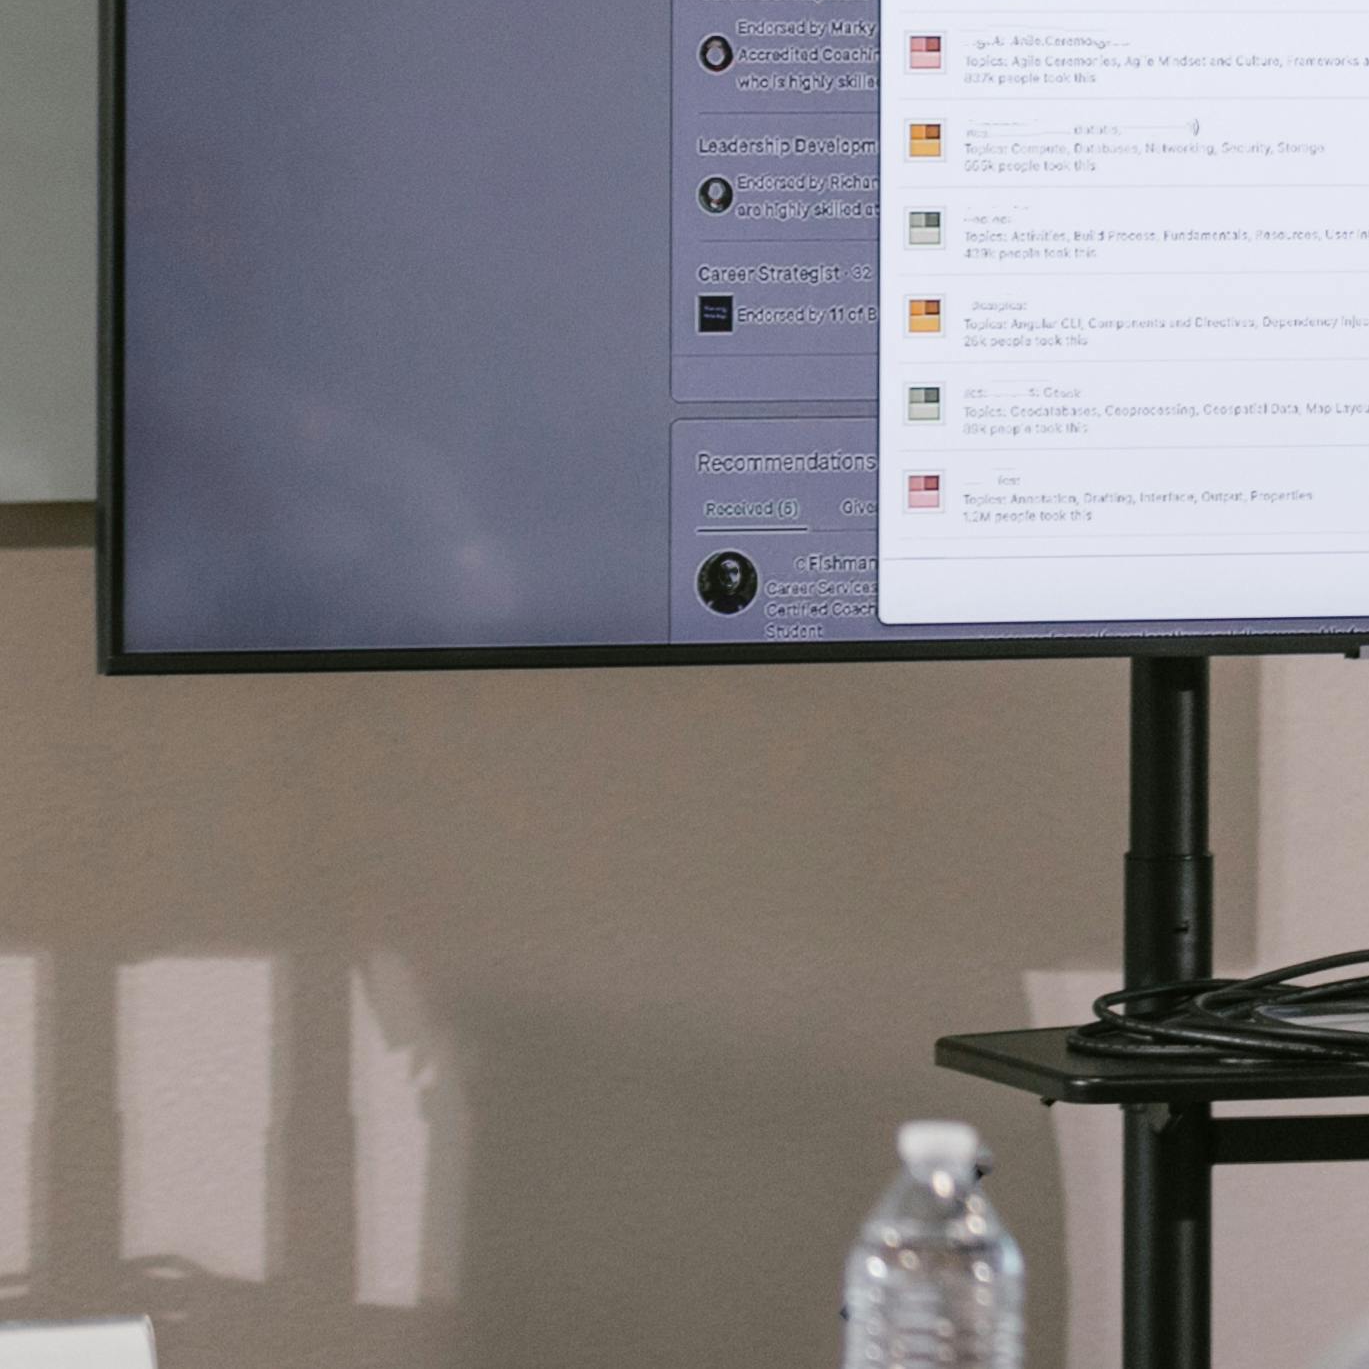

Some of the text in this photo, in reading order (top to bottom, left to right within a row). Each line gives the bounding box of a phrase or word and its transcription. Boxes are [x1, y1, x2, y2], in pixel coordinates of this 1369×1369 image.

[737, 20, 806, 35] Endorsed
[810, 20, 826, 37] by
[738, 48, 818, 63] Accredited
[738, 75, 768, 89] who
[789, 74, 834, 91] highly
[698, 138, 790, 156] Leadership
[737, 175, 825, 192] Endorsed by
[765, 202, 810, 220] highly
[698, 265, 872, 285] Career Strategist 32
[737, 308, 804, 323] Endorsed
[809, 308, 825, 325] by
[697, 451, 877, 473] Recommendations
[705, 501, 773, 517] Received
[765, 581, 817, 596] Career
